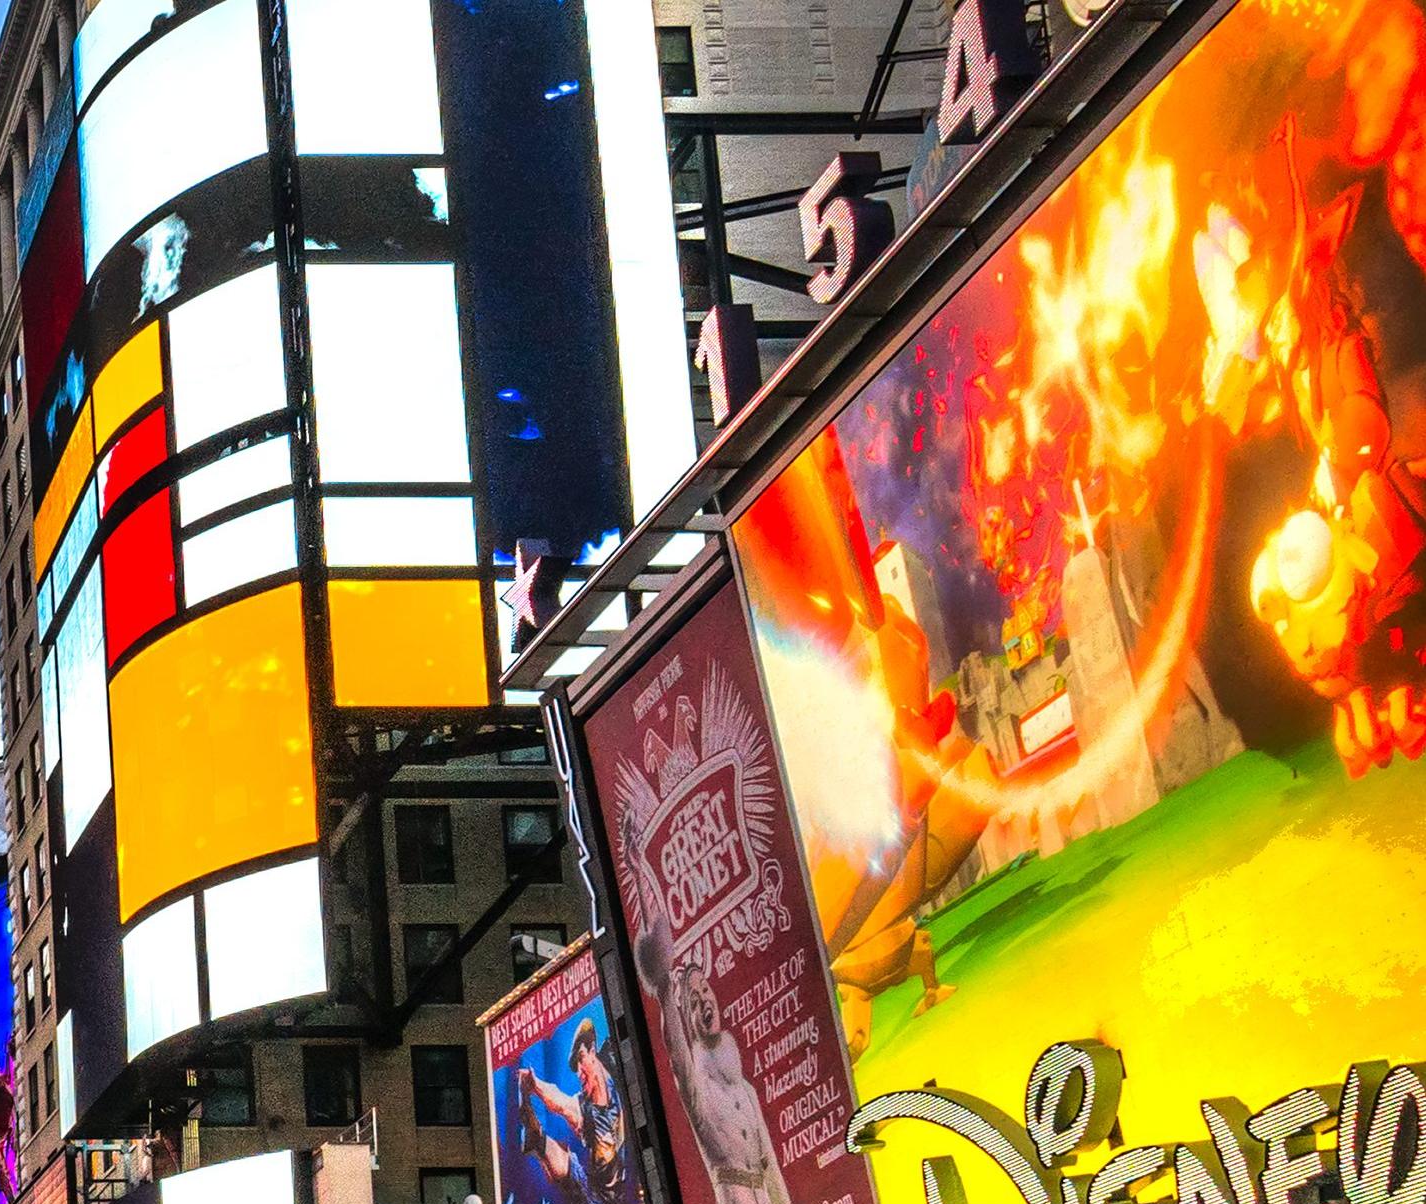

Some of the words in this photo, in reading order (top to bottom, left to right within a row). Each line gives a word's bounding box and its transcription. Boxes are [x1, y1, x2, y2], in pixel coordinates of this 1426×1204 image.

[660, 788, 729, 885] GREAT
[665, 829, 743, 931] COMET
[755, 966, 791, 1010] TALK
[789, 948, 807, 982] OF
[491, 1016, 510, 1049] BEST
[510, 996, 537, 1034] SCORE
[541, 975, 563, 1012] BEST
[497, 1034, 519, 1061] 2012
[522, 1014, 545, 1042] TONY
[548, 988, 580, 1024] AWARD
[741, 1012, 771, 1049] THE
[752, 1050, 764, 1079] A
[762, 1015, 821, 1070] stunning
[763, 1047, 821, 1105] blazingly
[778, 1076, 842, 1135] ORIGINAL
